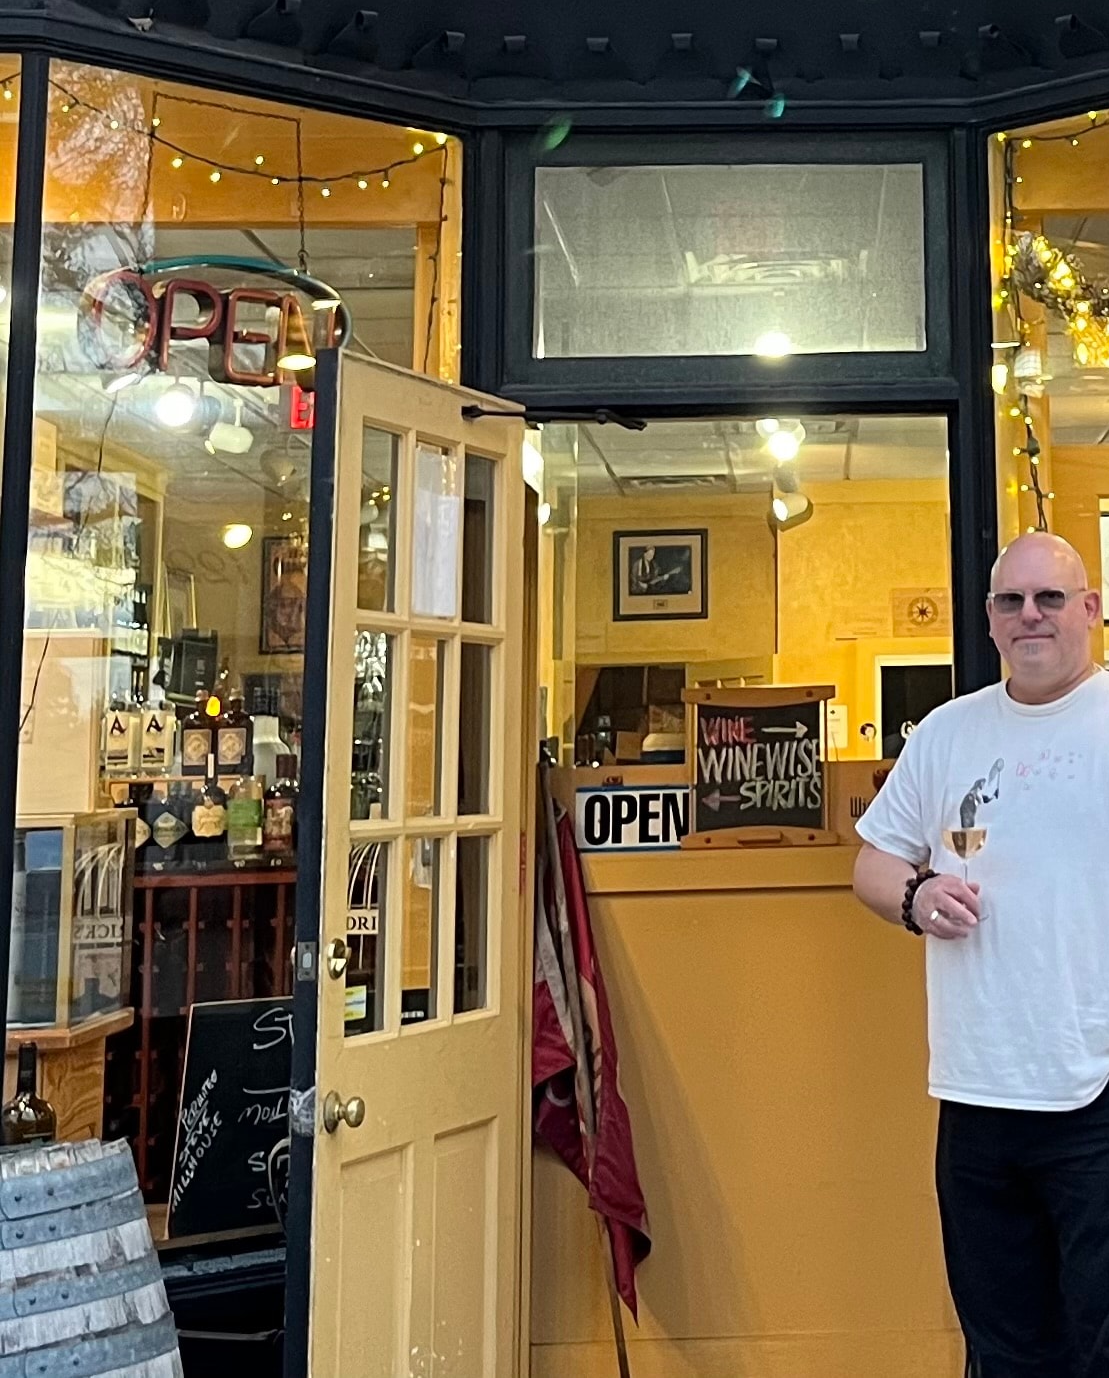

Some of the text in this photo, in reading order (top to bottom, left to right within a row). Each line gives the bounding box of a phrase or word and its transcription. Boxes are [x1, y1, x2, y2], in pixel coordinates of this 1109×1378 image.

[88, 268, 337, 386] OPEN
[700, 716, 757, 746] WINE
[698, 738, 821, 784] WINEWISE
[740, 777, 822, 812] SPIRITS
[584, 792, 690, 846] OPEN
